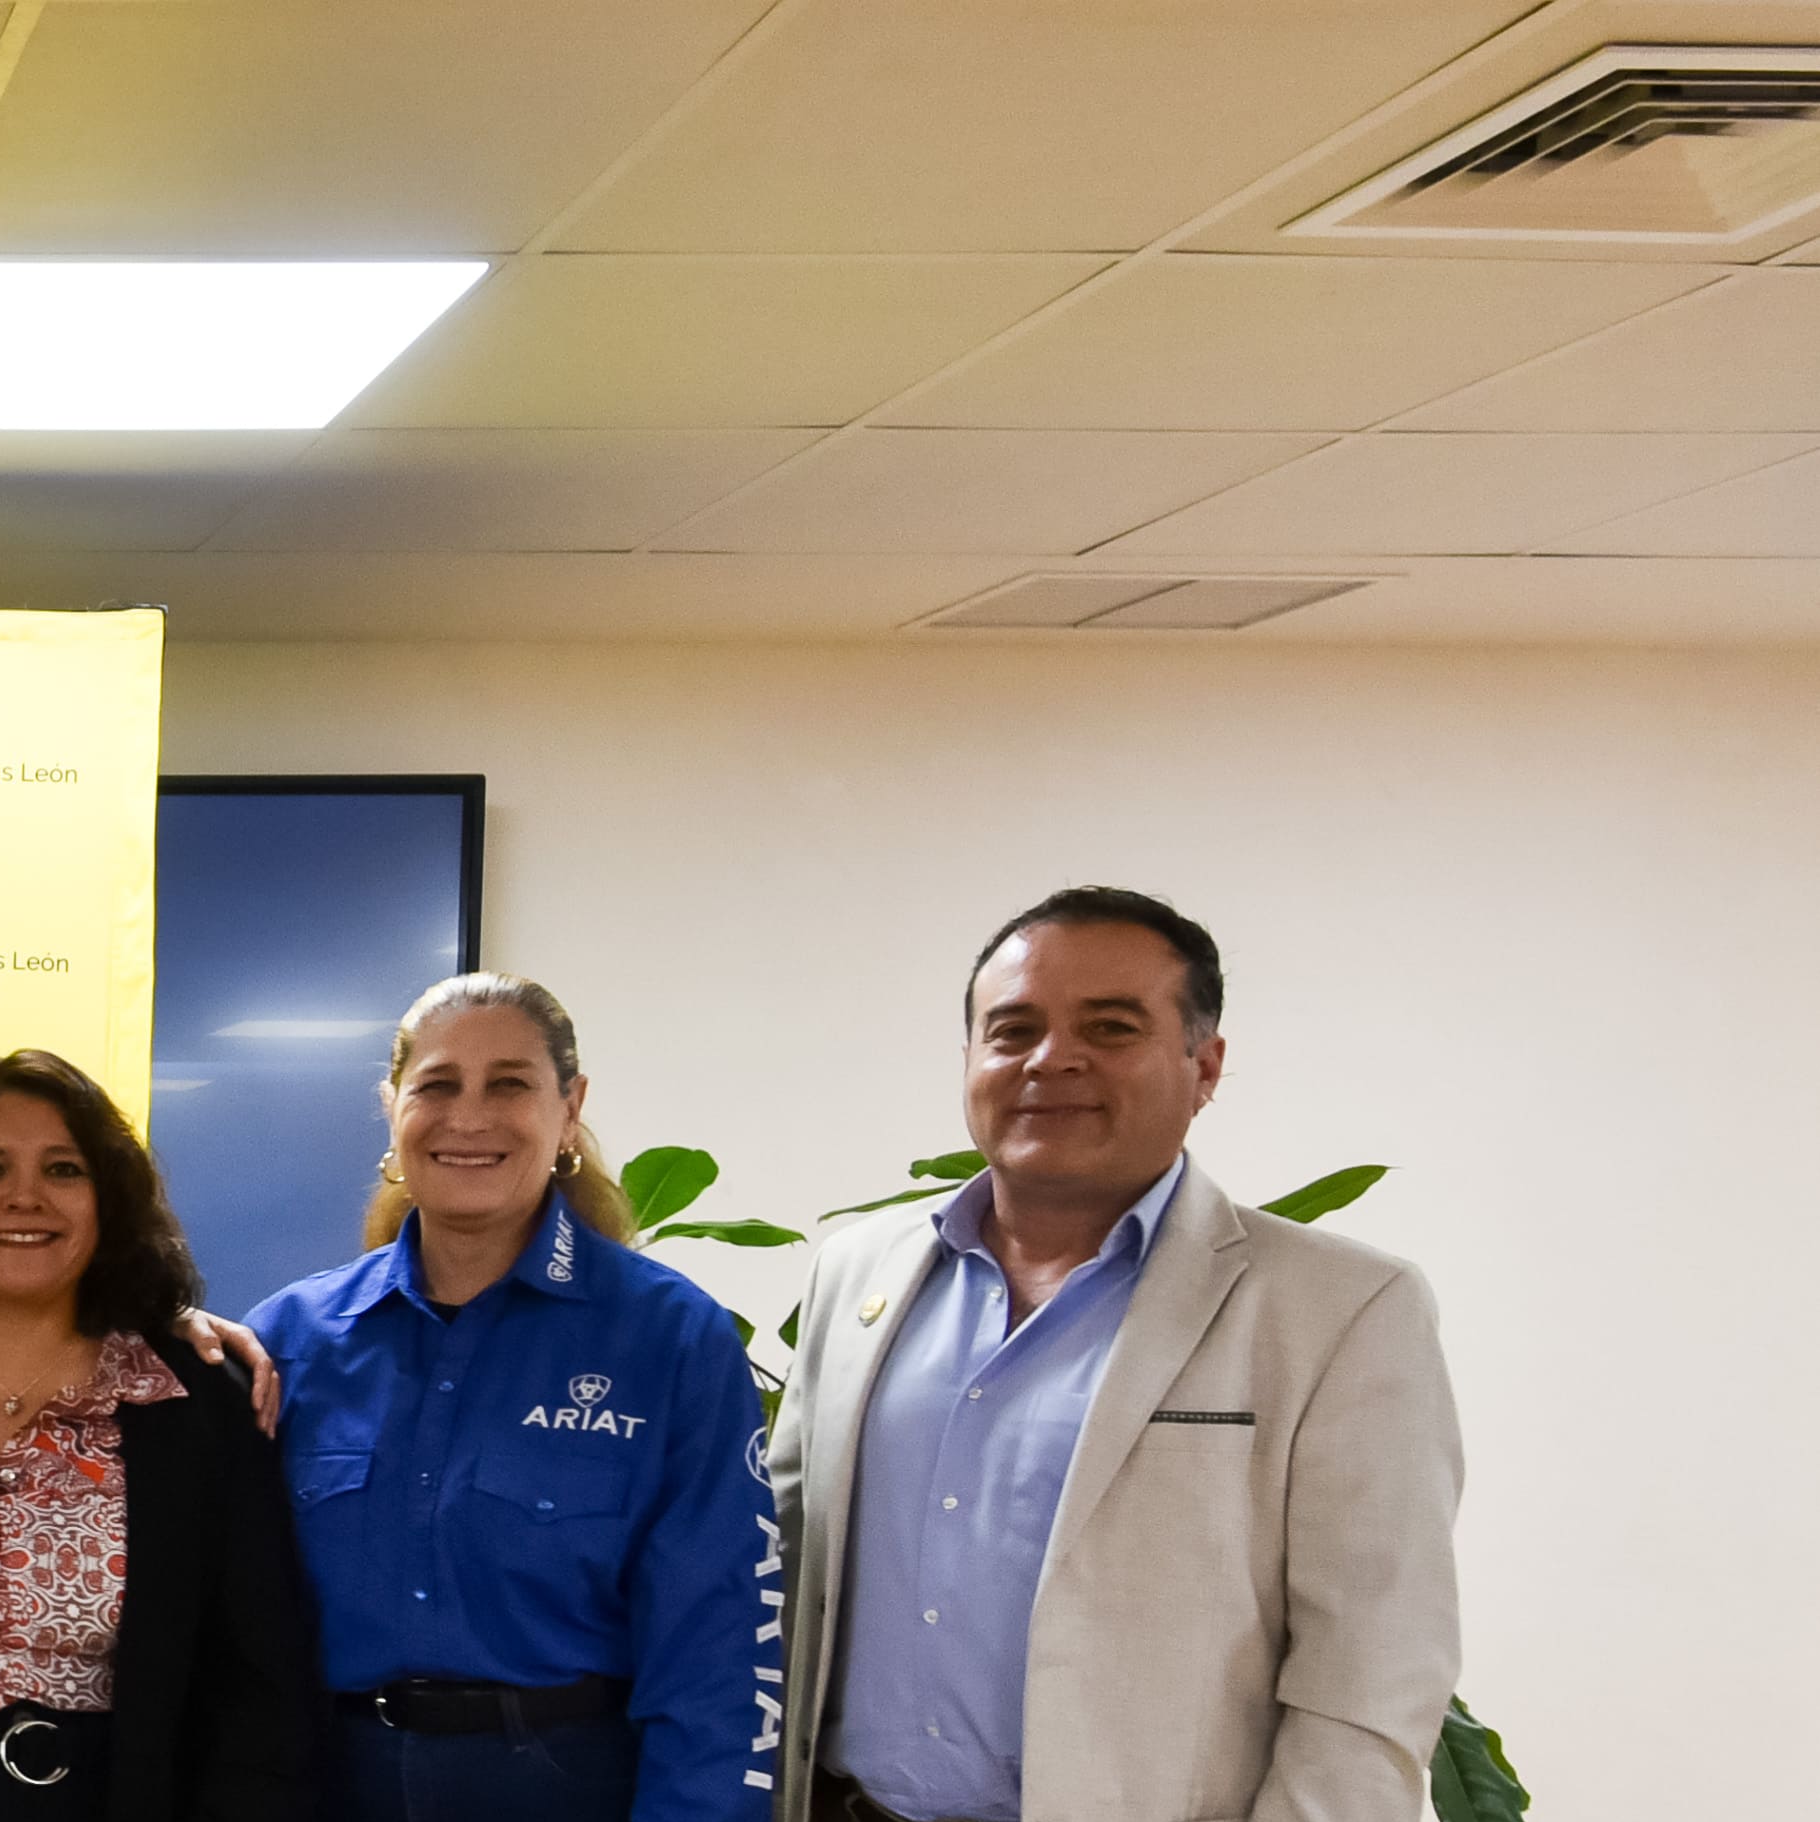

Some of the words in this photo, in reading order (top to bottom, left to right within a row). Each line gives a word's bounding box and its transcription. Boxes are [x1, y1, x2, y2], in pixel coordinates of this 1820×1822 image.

[21, 763, 77, 784] León
[13, 951, 69, 973] León
[551, 1209, 574, 1270] ARIAT
[523, 1405, 646, 1440] ARIAT
